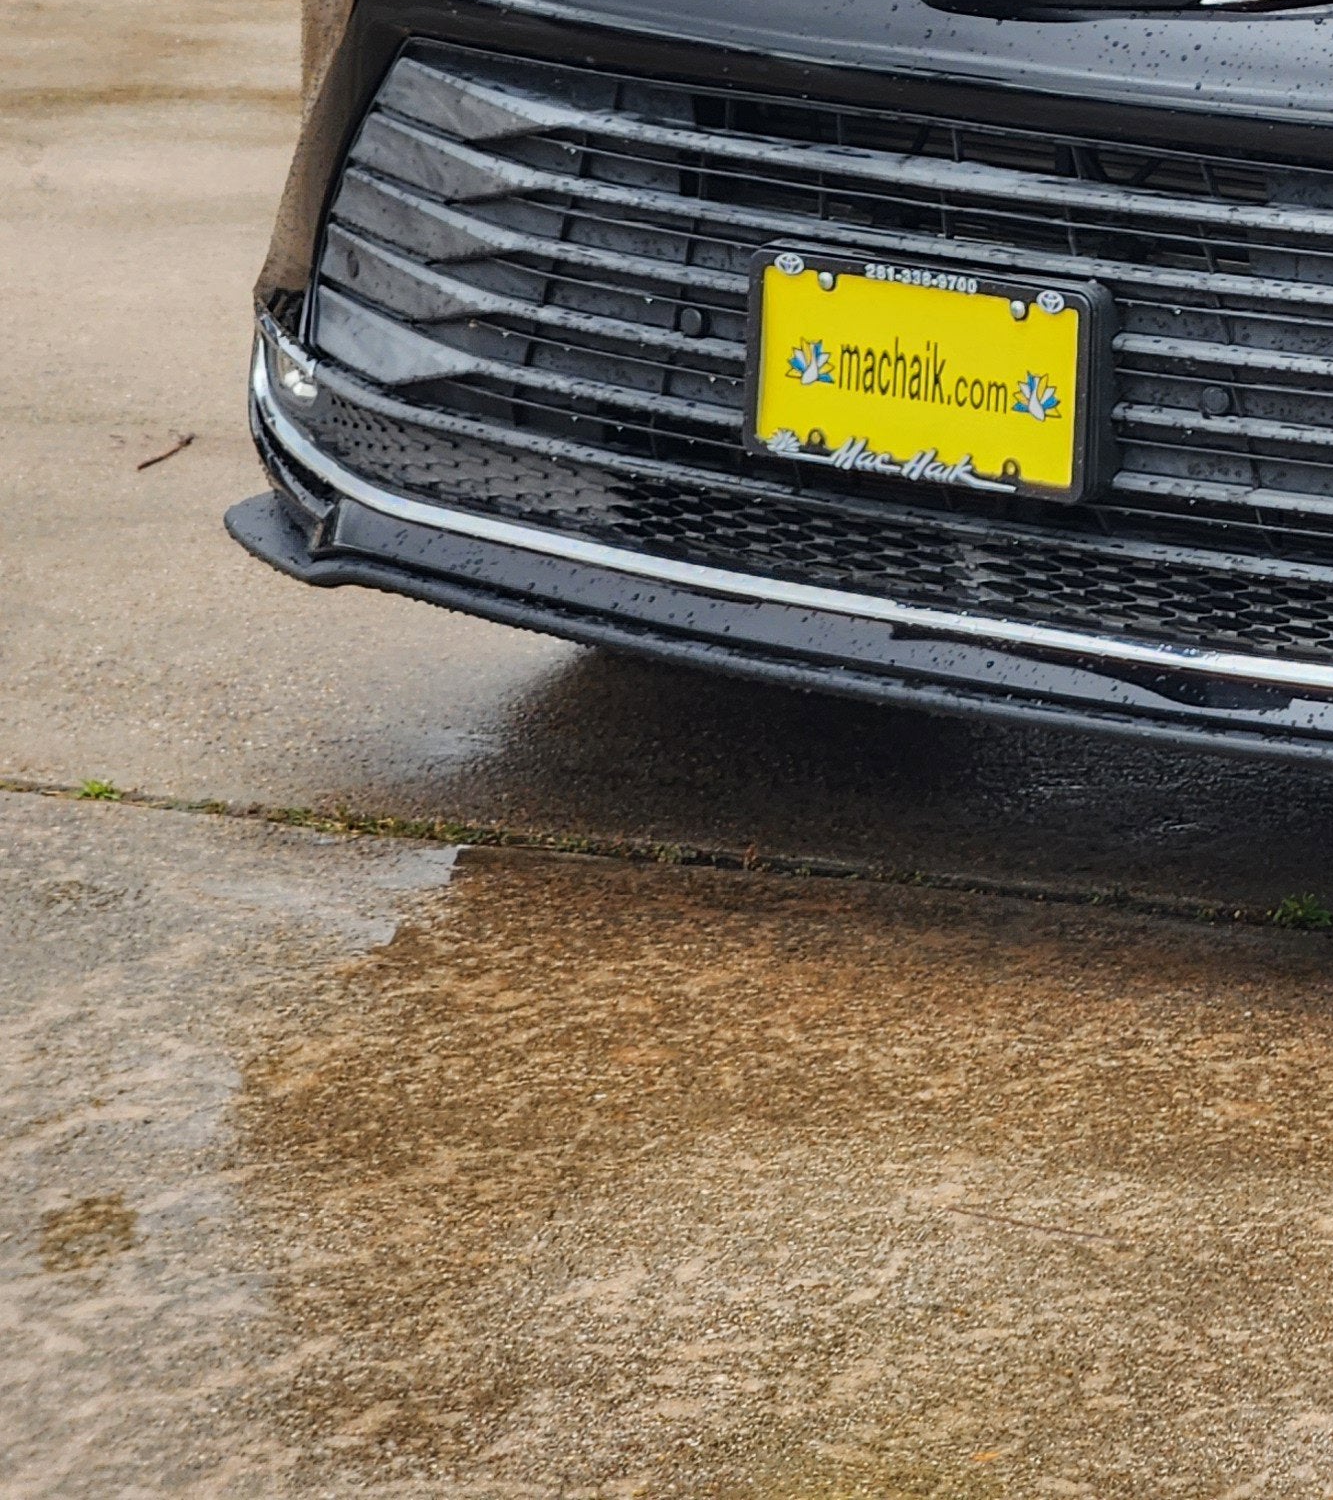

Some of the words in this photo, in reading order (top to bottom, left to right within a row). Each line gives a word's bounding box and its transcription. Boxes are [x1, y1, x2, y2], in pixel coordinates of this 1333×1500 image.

[838, 336, 1008, 414] machaik.com
[832, 435, 900, 473] Mac
[901, 447, 983, 483] Haik
